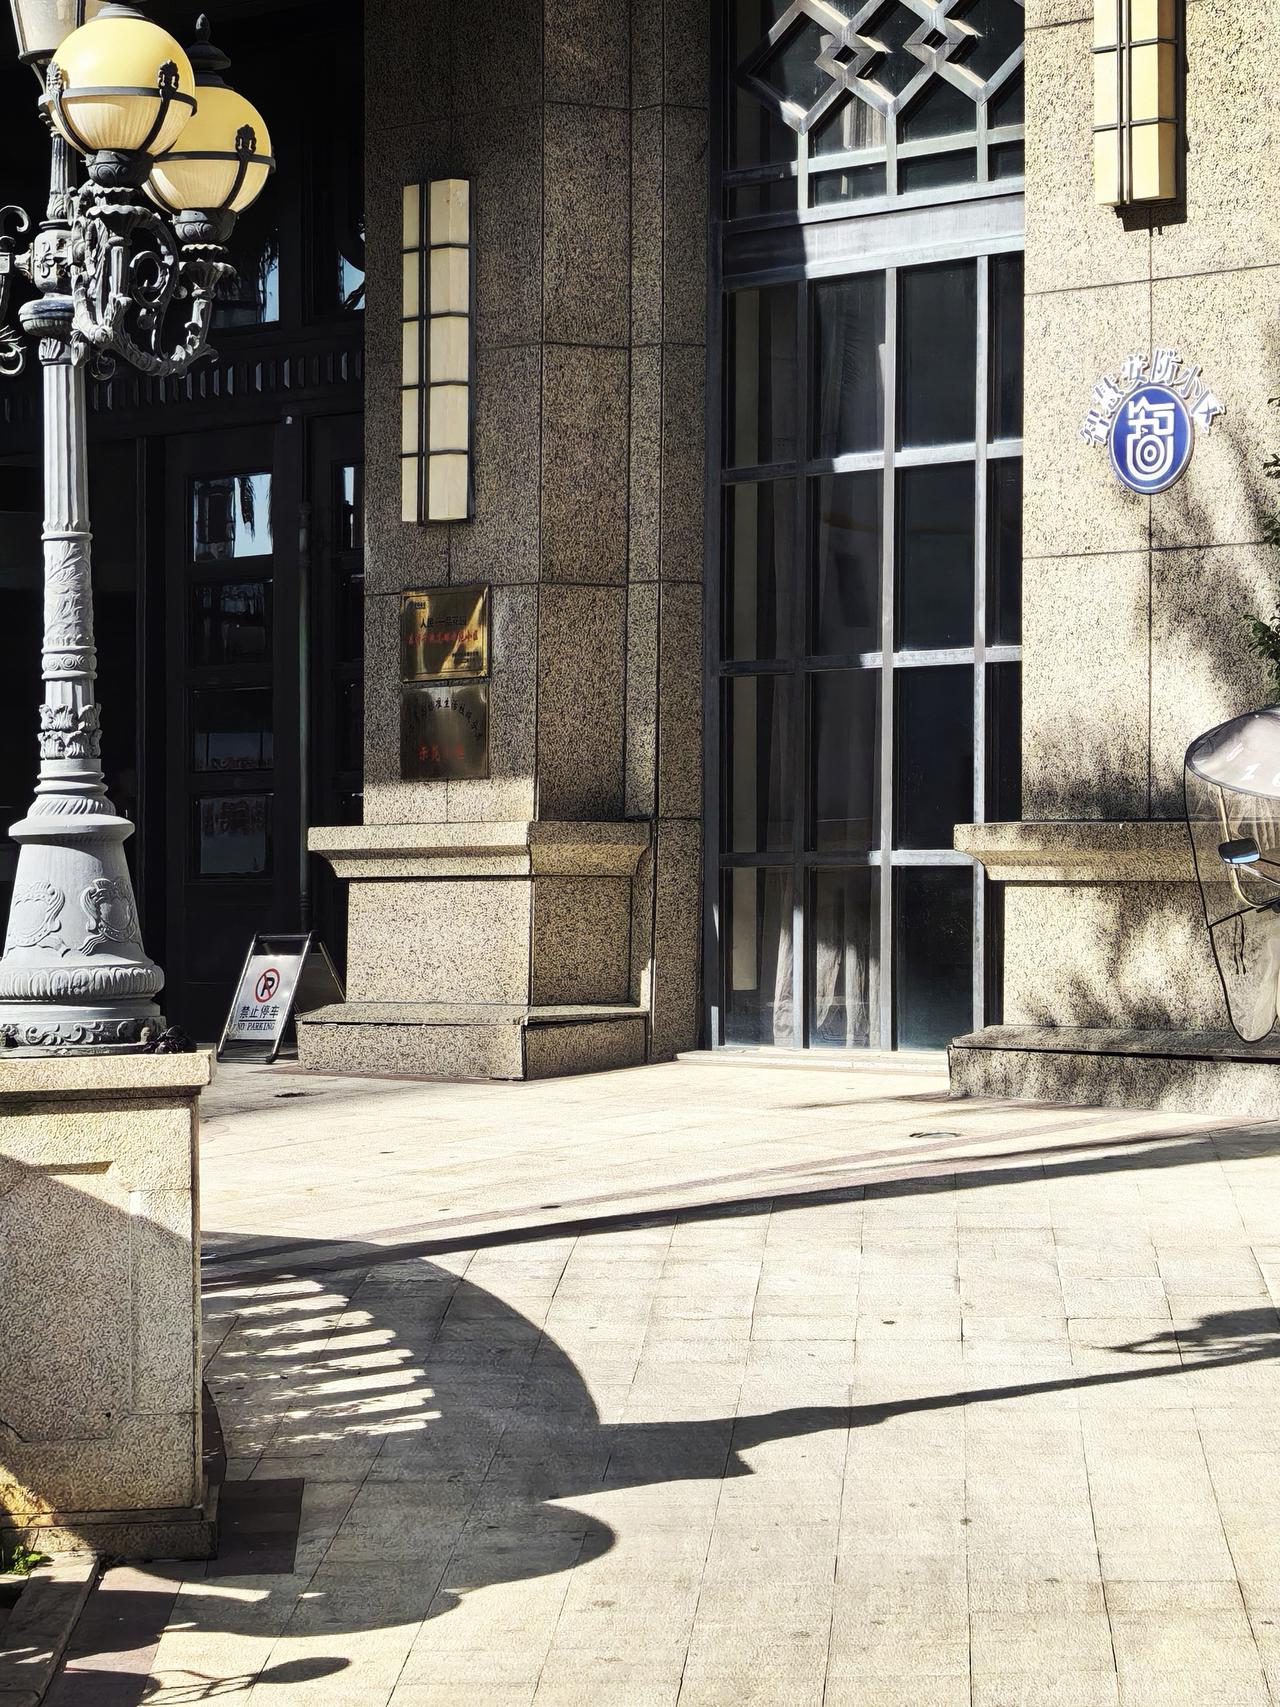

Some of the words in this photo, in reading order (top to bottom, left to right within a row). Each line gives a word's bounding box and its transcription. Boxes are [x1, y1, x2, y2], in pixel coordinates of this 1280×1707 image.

[1080, 348, 1226, 446] 智慧安防小区
[239, 1005, 280, 1019] 禁止停车
[237, 1022, 246, 1031] NO
[247, 1022, 276, 1031] PARKING
